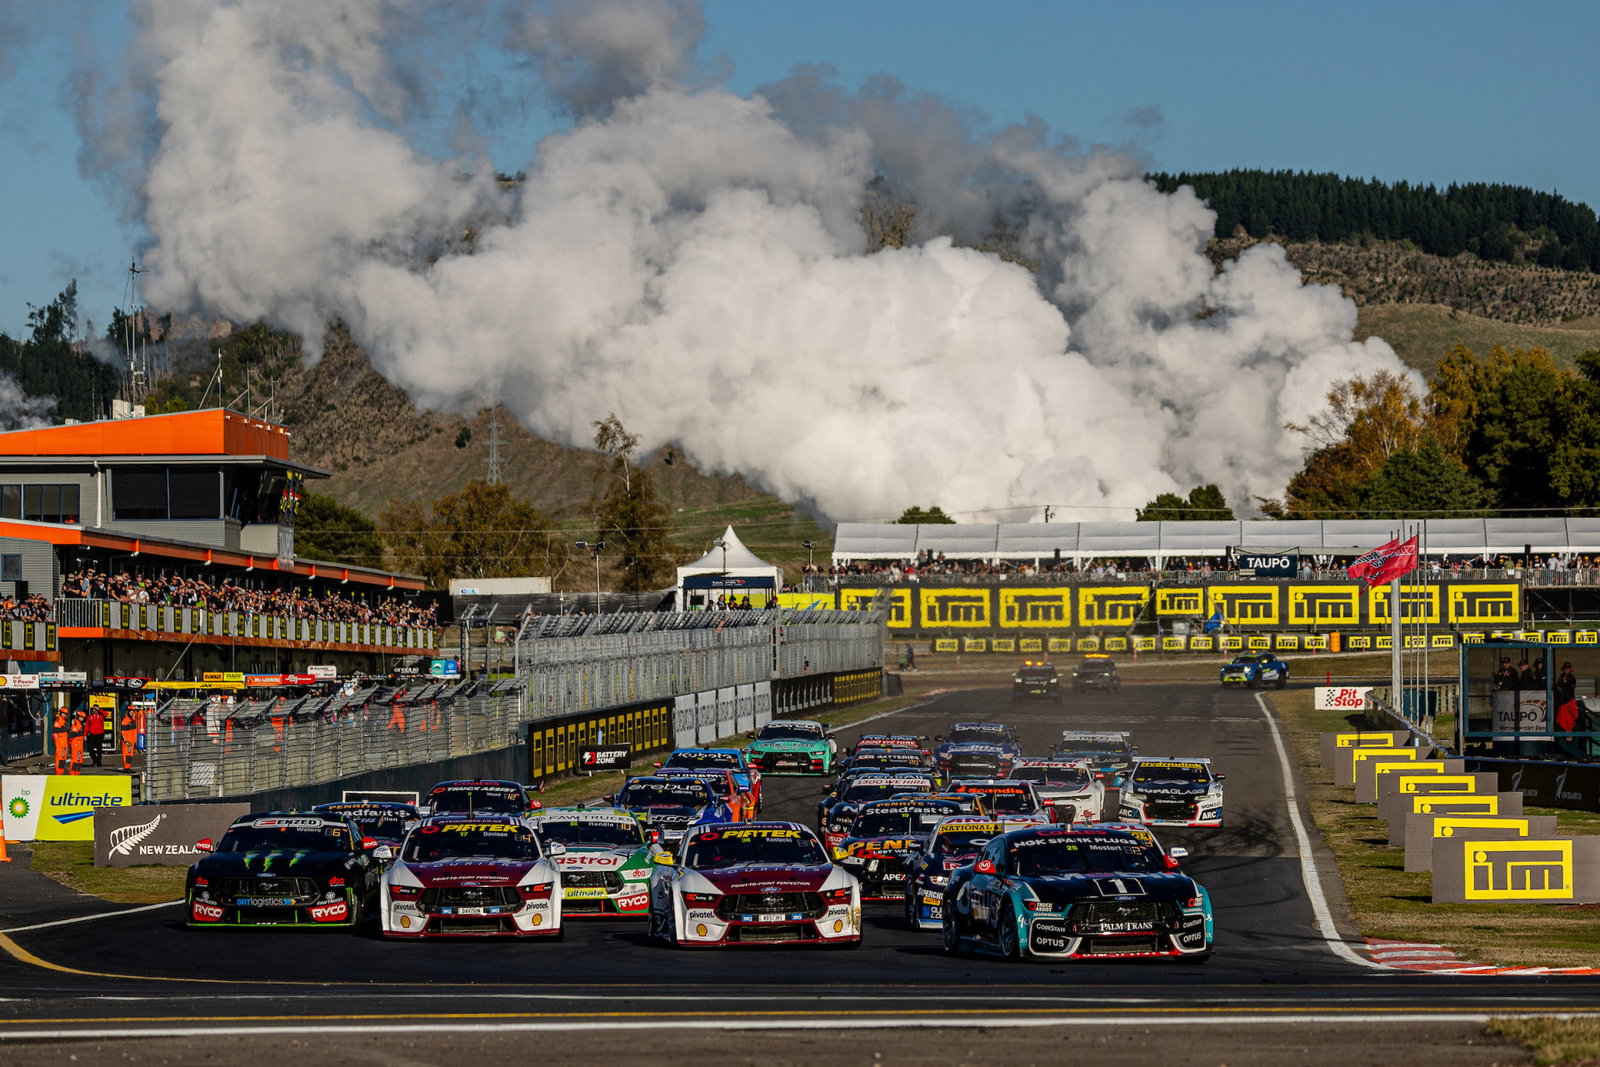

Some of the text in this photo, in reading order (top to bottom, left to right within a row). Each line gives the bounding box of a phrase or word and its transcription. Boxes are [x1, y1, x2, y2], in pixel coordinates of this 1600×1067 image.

[1247, 556, 1290, 568] TAUPŌ
[1340, 688, 1357, 699] Pit
[1334, 697, 1363, 708] Stop
[50, 792, 123, 806] ultimate
[441, 824, 520, 833] PIRTEK
[941, 824, 993, 832] NATIONAL
[722, 830, 802, 839] PIRTEK
[1014, 838, 1046, 848] NGK
[1094, 837, 1138, 845] PLUGS
[139, 845, 213, 855] NEW ZEALA
[554, 856, 618, 866] astrol
[632, 868, 646, 877] dba
[882, 873, 907, 881] APEX
[329, 876, 345, 885] dba
[1107, 879, 1128, 893] 1
[567, 889, 604, 897] ultimate
[236, 897, 283, 907] SRTlogistics
[617, 894, 648, 908] RYCO
[195, 904, 222, 918] RYCO
[312, 904, 346, 918] RYCO
[1099, 921, 1153, 931] PALM TRANS
[1036, 937, 1064, 947] OPTUS
[1183, 932, 1202, 943] OPTUS
